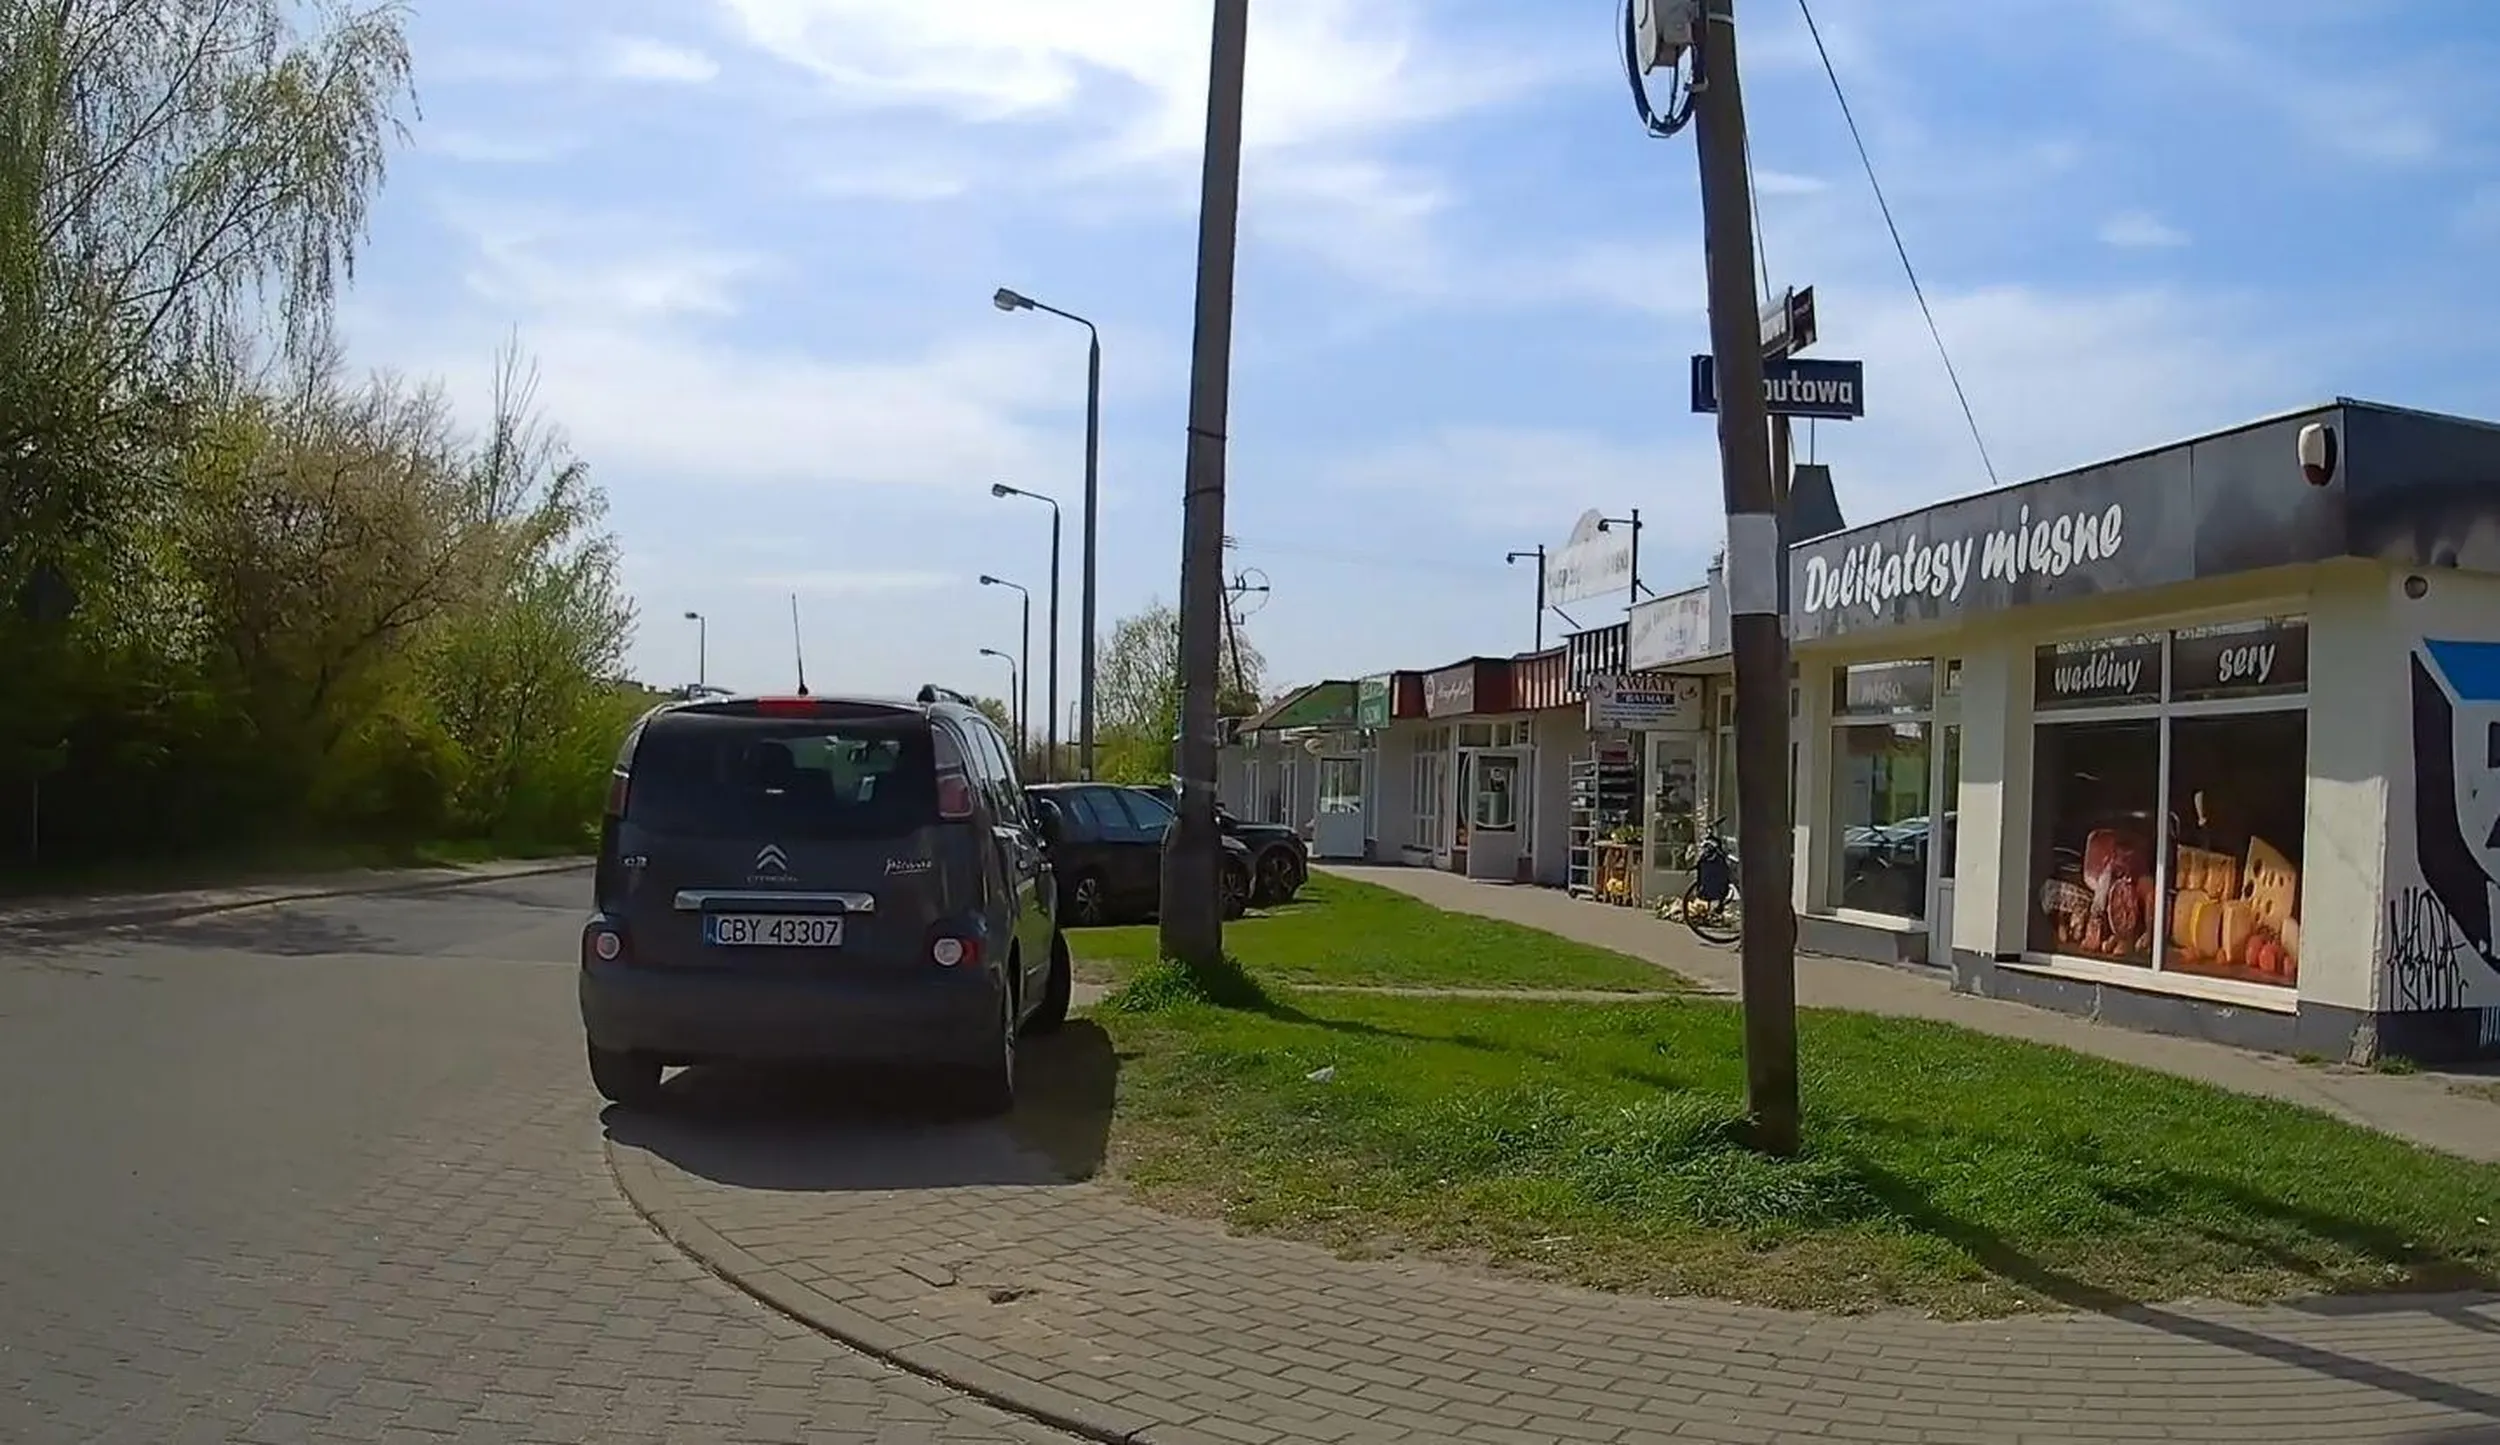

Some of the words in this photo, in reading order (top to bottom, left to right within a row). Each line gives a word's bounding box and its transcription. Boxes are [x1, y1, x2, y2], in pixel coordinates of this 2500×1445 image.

[1804, 534, 1974, 615] Delikatesy
[1981, 504, 2122, 583] mięsne
[2219, 644, 2275, 682] sery
[1615, 677, 1677, 692] KWIATY
[718, 918, 761, 942] CBY
[768, 919, 839, 944] 43307
